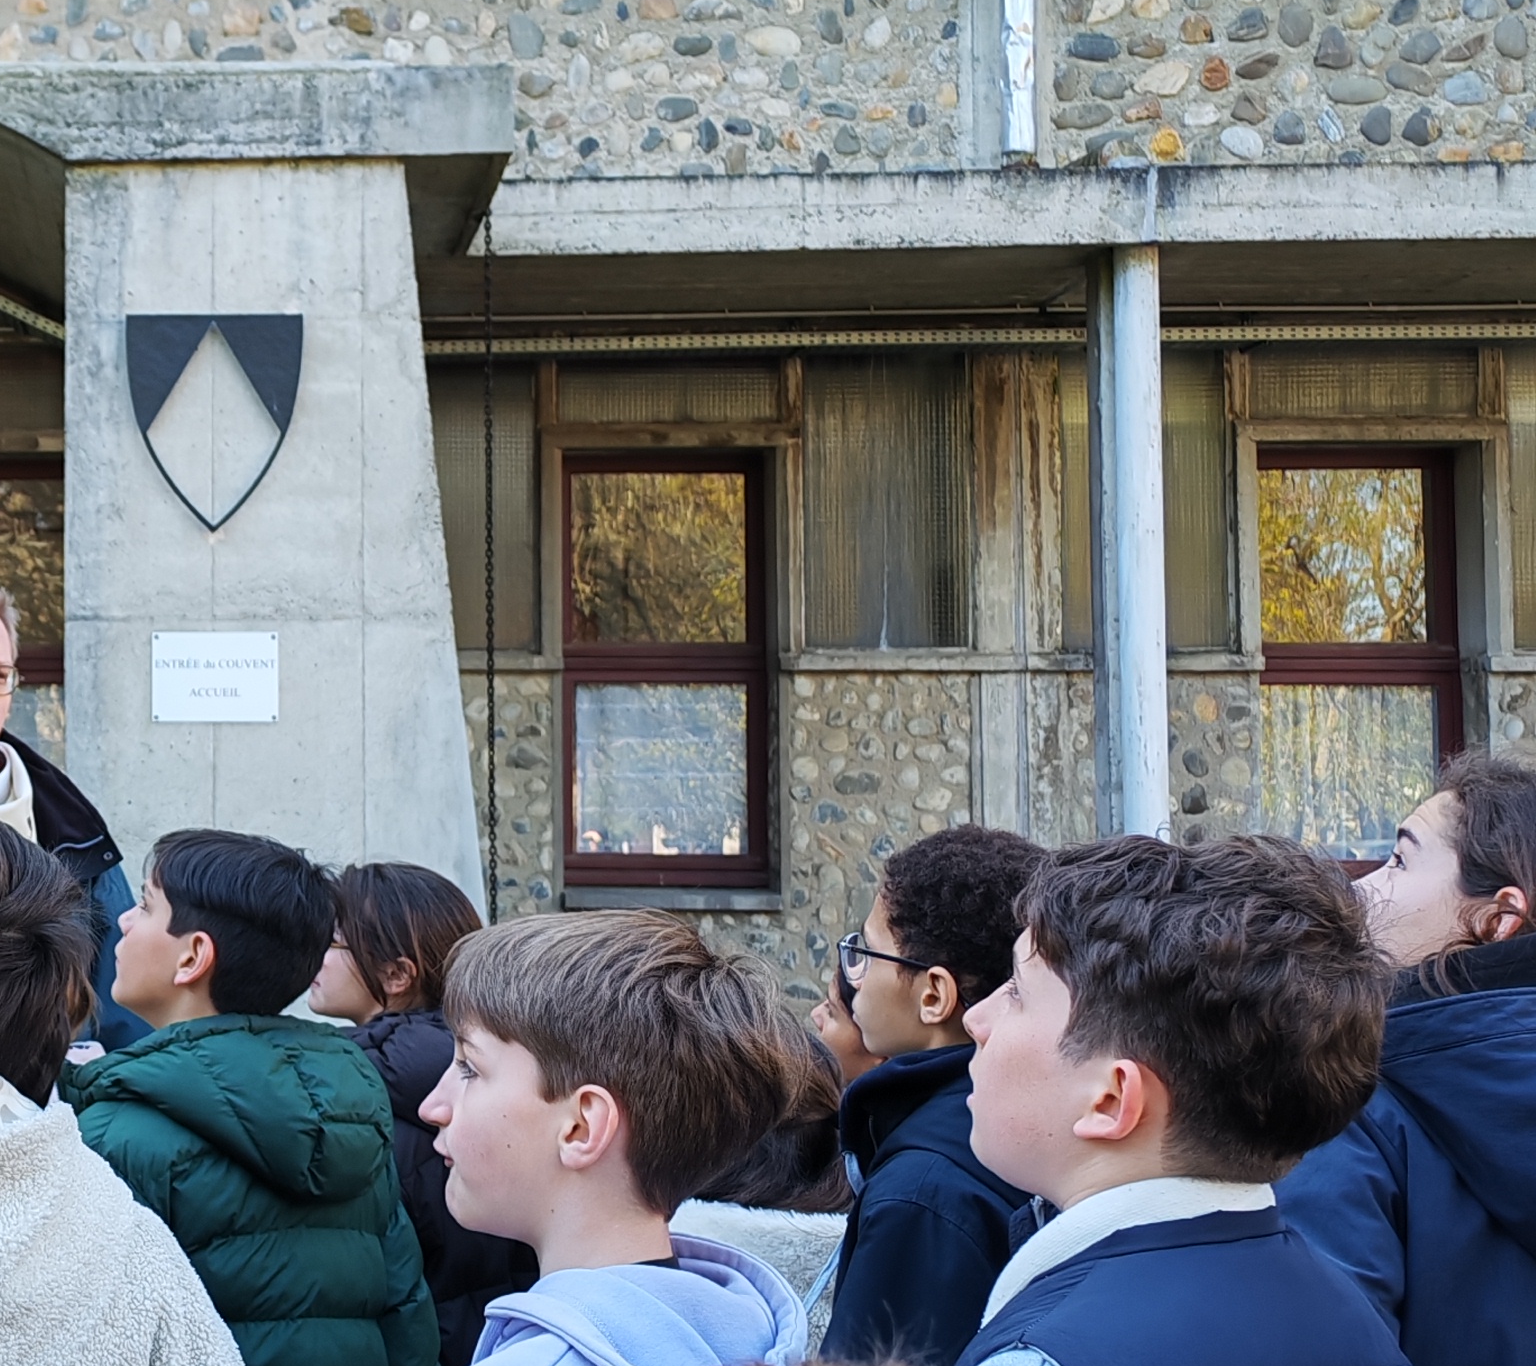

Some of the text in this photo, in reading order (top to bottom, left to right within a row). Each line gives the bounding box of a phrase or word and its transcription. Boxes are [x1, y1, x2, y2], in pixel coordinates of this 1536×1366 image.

[155, 657, 276, 669] ENTRÉE du COUVENT
[189, 687, 241, 697] ACCUEIL
